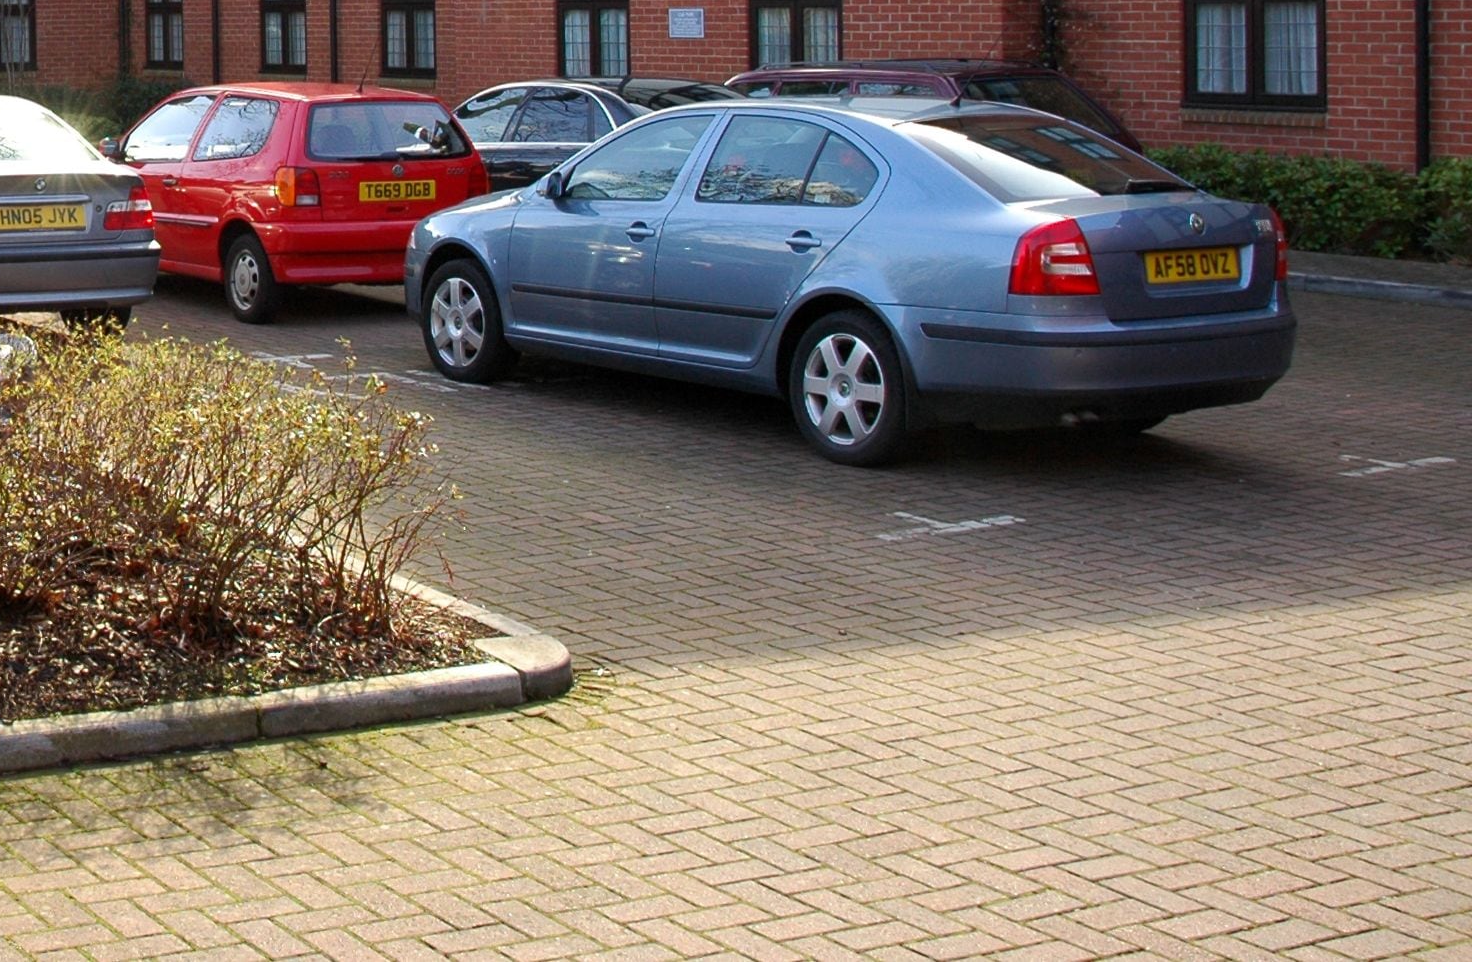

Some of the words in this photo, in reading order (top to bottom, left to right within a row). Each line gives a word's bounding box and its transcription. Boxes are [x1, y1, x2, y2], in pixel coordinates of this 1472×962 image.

[366, 183, 401, 199] T669
[405, 181, 431, 197] DGB
[0, 207, 43, 225] HN05
[48, 207, 78, 224] JYK
[1154, 253, 1196, 279] AF58
[1199, 252, 1231, 275] OVZ
